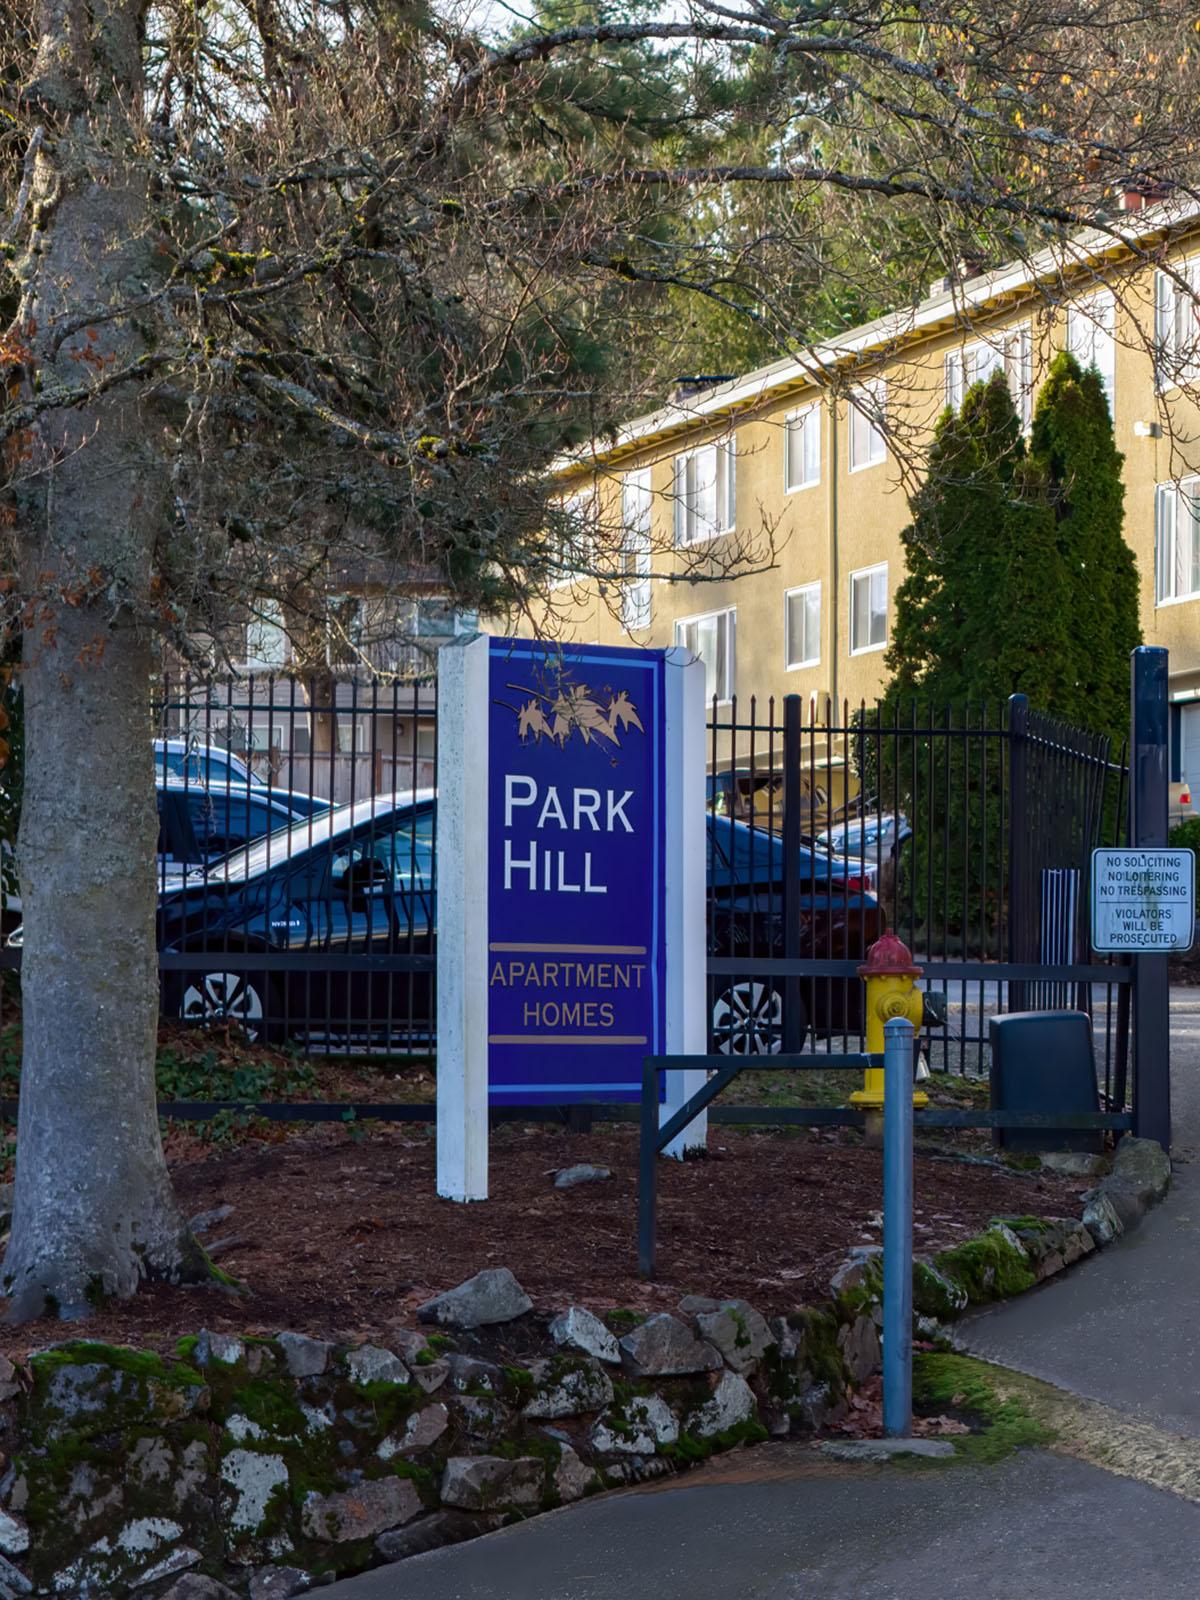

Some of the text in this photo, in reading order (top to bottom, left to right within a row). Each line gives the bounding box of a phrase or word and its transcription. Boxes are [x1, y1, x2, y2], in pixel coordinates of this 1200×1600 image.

[504, 774, 635, 833] PARK
[504, 839, 608, 894] HILL
[1106, 857, 1181, 868] NO SOLICITING
[1108, 871, 1180, 882] NO LOITERING
[1100, 885, 1187, 896] NO TRESPASSING
[1115, 909, 1172, 919] VIOLATORS
[1122, 921, 1164, 931] WILL BE
[1110, 933, 1177, 944] PROSECUTED
[490, 962, 646, 989] APARTMENT
[523, 1001, 615, 1027] HOMES
